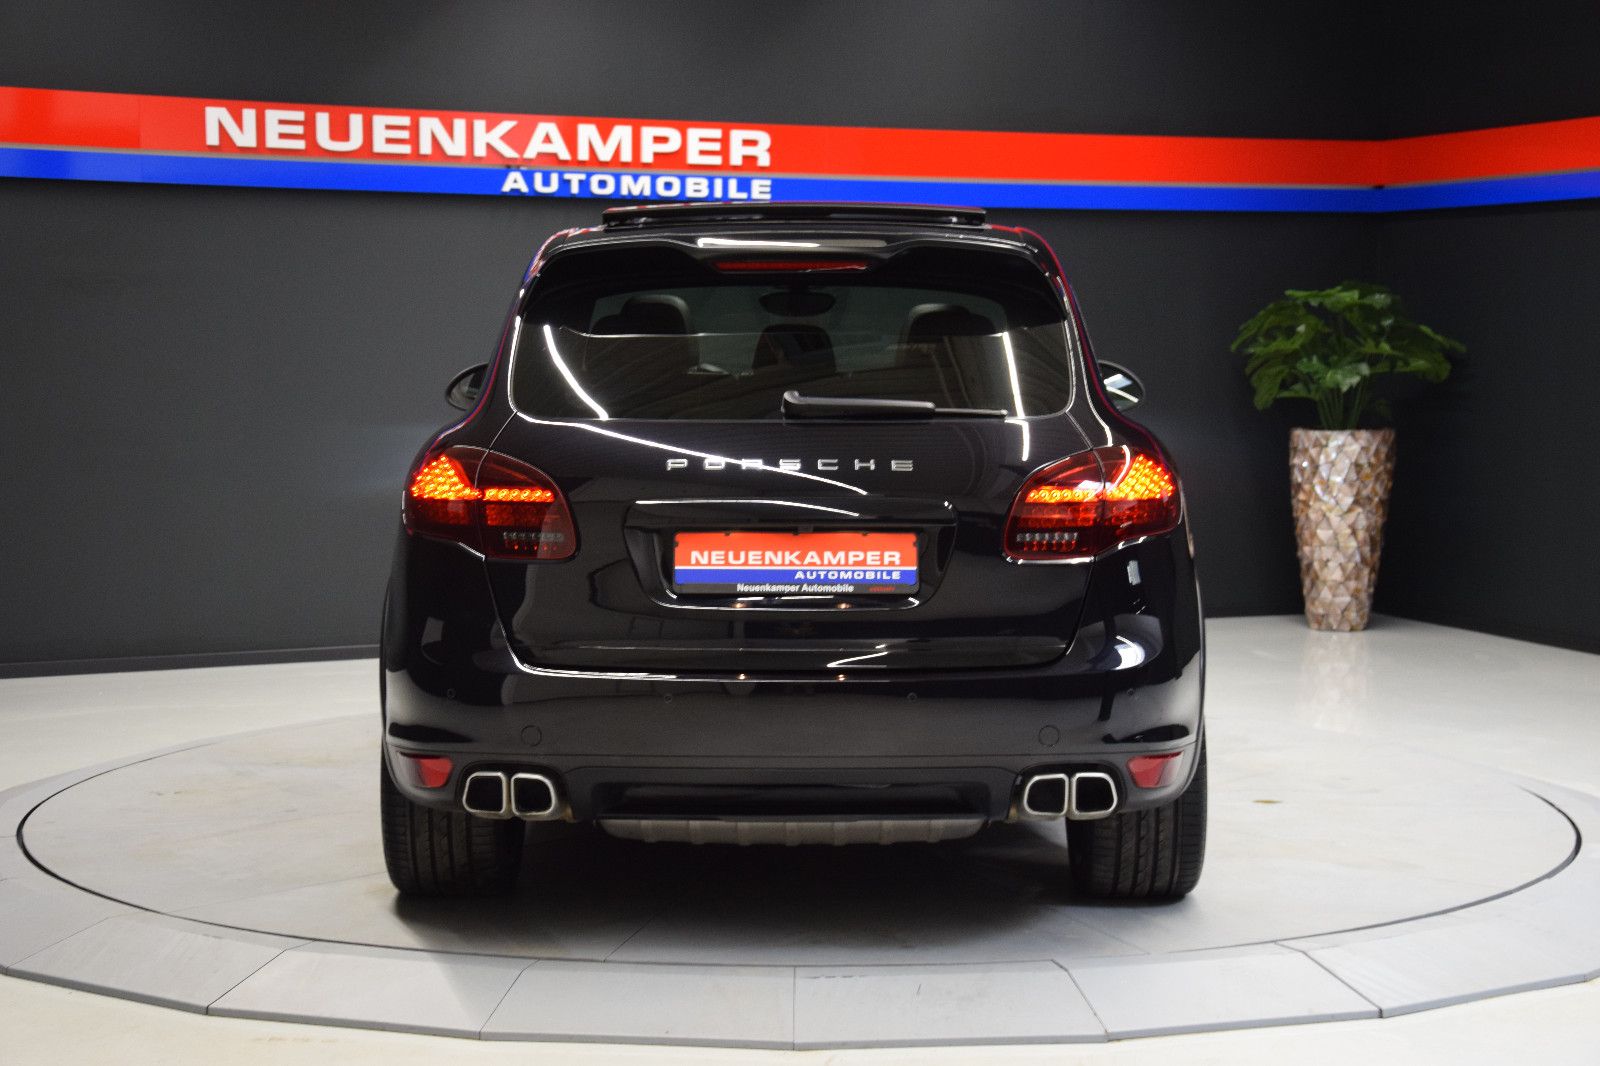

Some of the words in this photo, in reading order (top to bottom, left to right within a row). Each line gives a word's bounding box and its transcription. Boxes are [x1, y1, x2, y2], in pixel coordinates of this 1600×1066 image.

[204, 106, 773, 168] NEUENKAMPER
[501, 171, 773, 200] AUTOMOBILE
[666, 458, 914, 471] PORSCHE
[690, 550, 902, 566] NEUENKAMPER
[794, 570, 902, 580] AUTOMOBILE
[736, 583, 800, 594] Neuenkamper
[801, 583, 855, 593] Automobile
